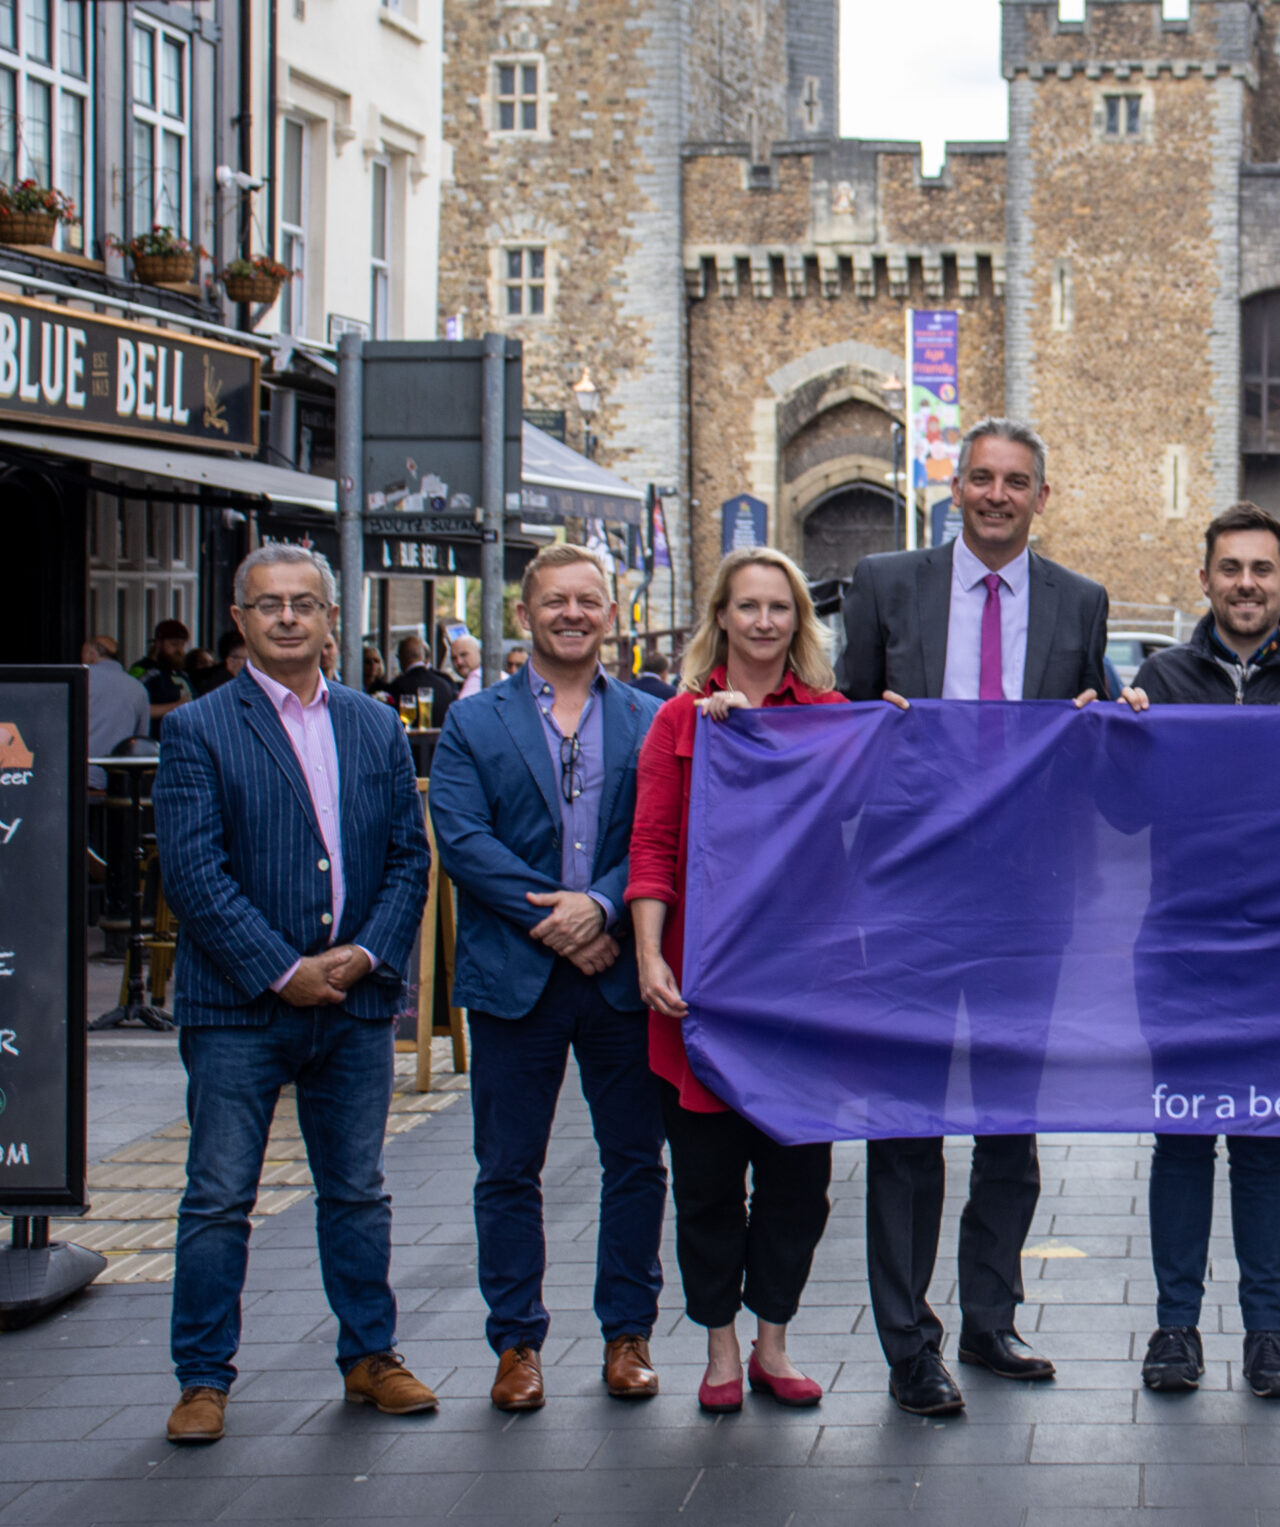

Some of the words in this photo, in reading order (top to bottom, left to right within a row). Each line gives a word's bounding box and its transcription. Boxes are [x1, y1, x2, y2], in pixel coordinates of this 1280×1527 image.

[0, 312, 87, 409] BLUE
[116, 336, 190, 426] BELL
[1152, 1083, 1206, 1119] for
[1216, 1094, 1235, 1118] a
